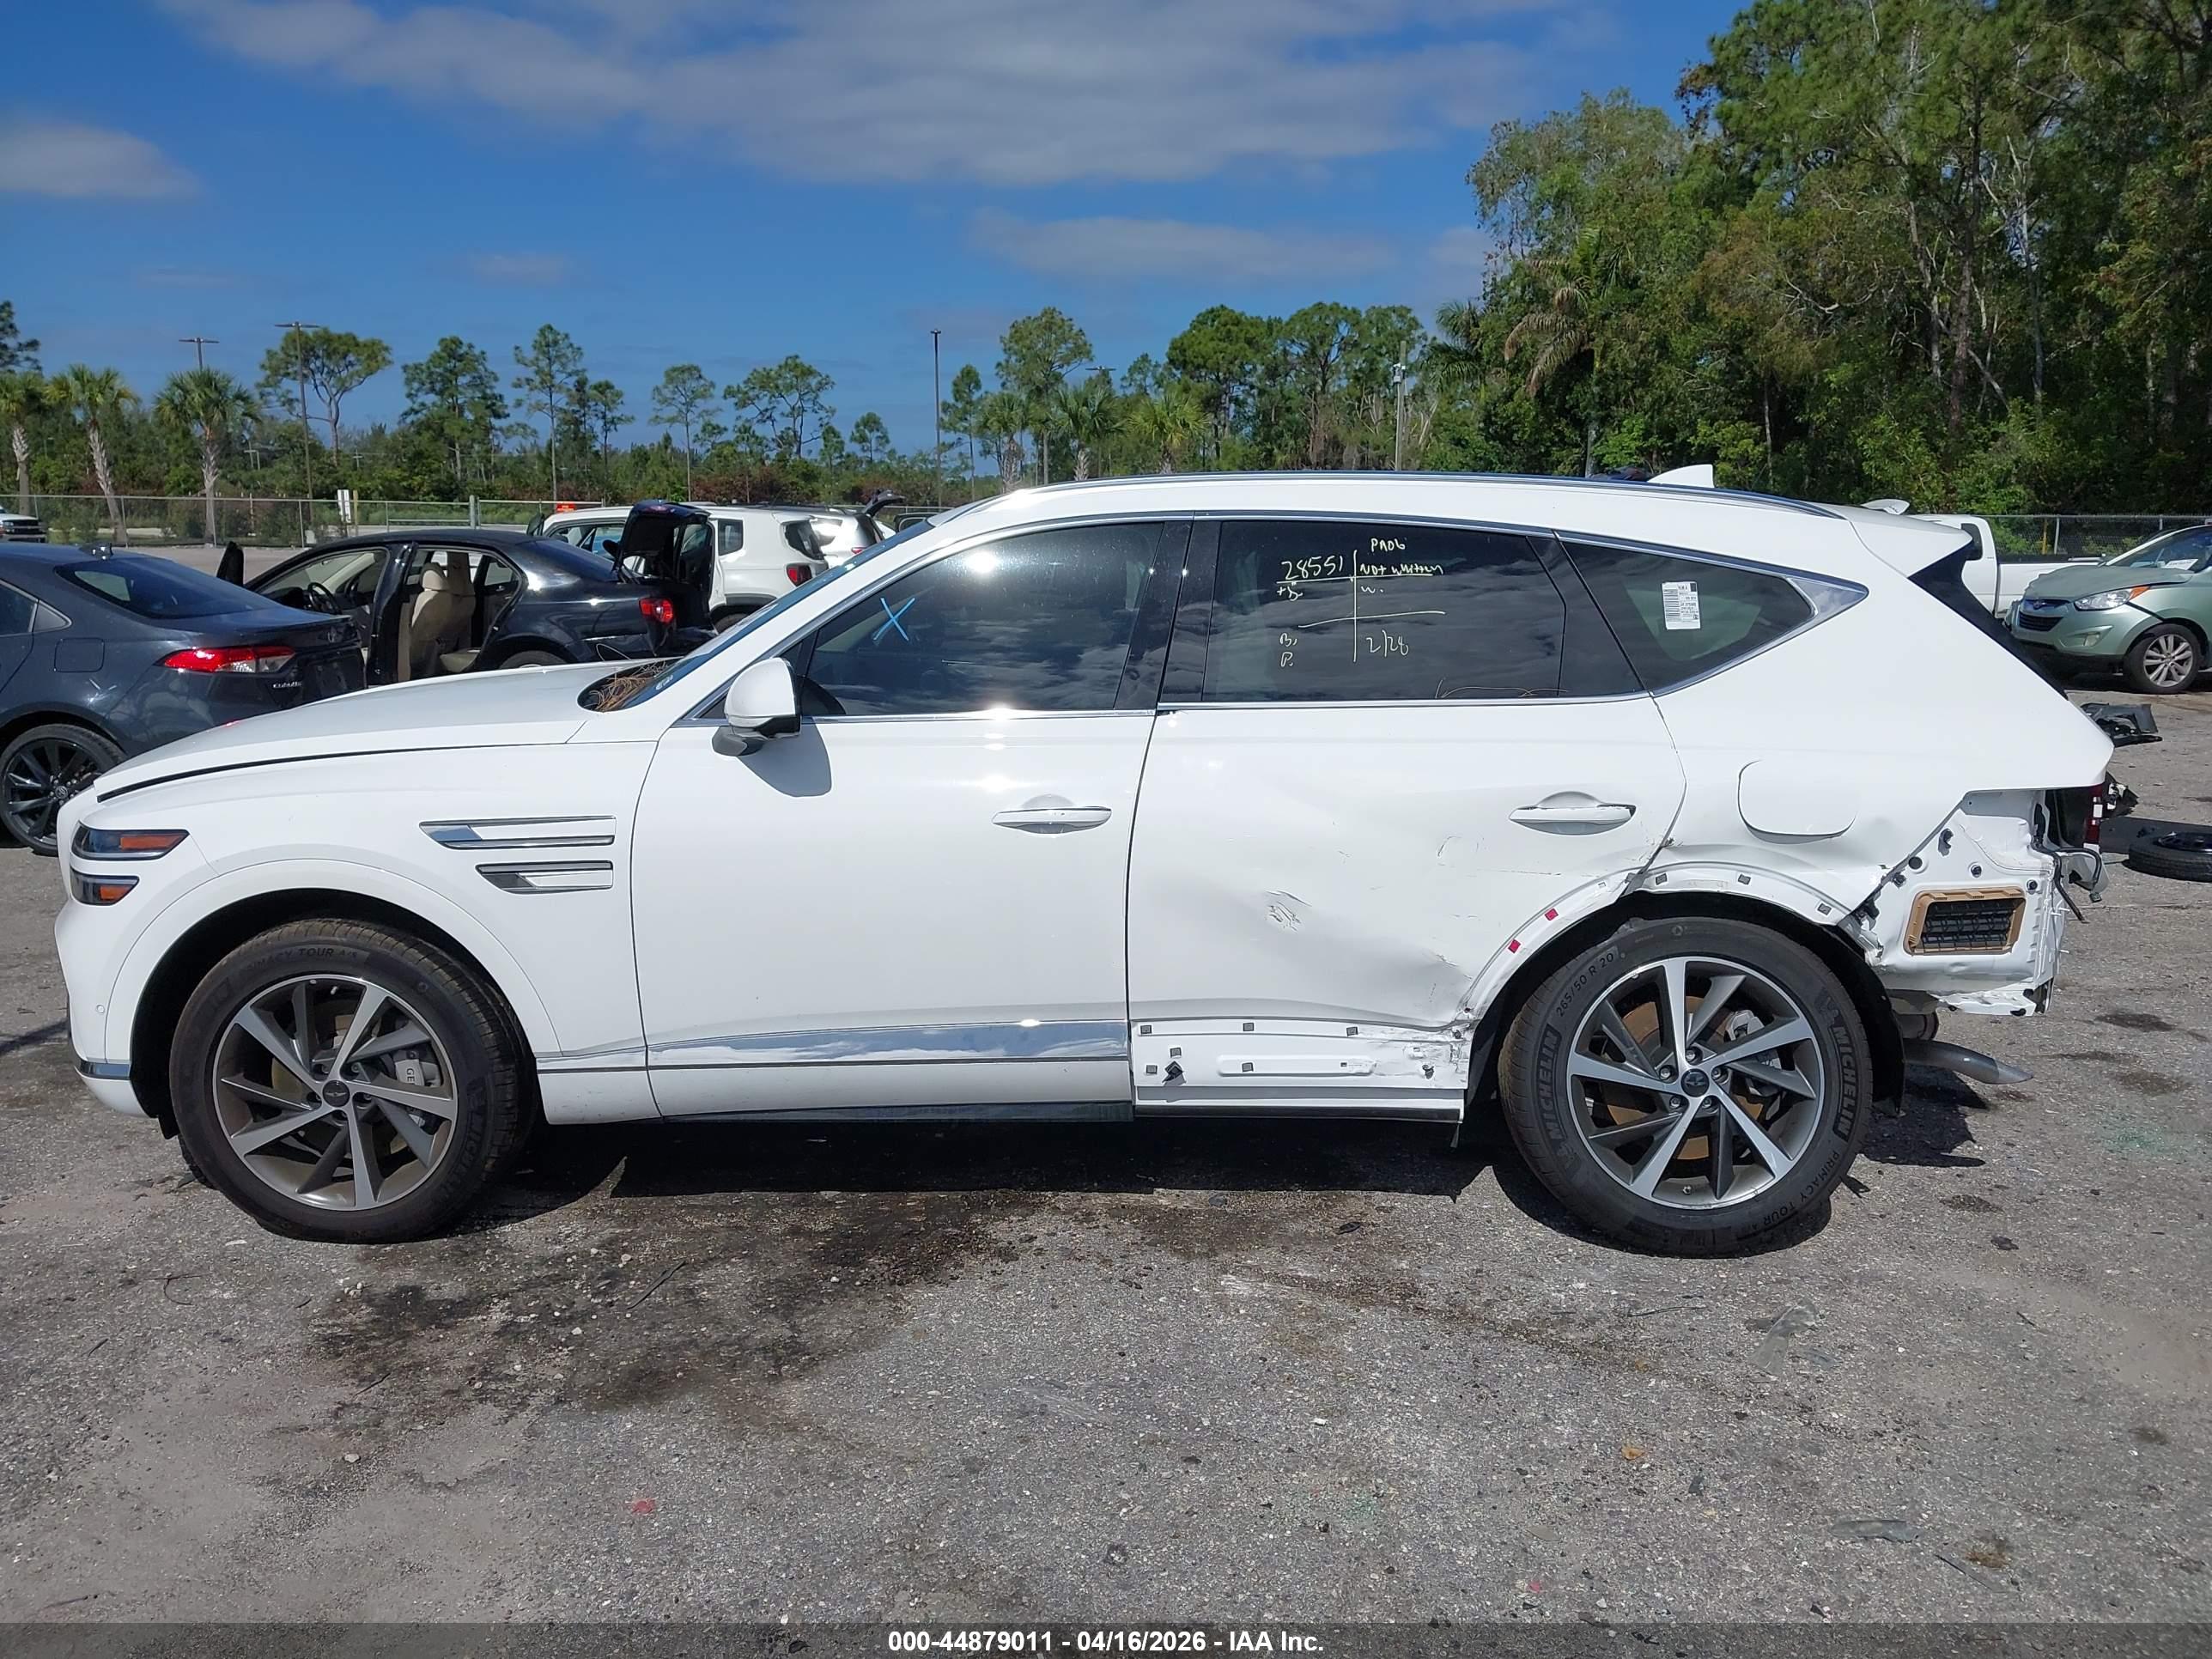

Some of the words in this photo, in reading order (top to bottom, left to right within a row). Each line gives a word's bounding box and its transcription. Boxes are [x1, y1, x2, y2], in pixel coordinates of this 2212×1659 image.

[298, 947, 334, 957] TOUR
[1556, 974, 1588, 1017] 265/50
[1588, 965, 1598, 976] R
[1599, 952, 1614, 968] 20
[1538, 1027, 1563, 1139] MICHELIN
[1833, 1026, 1857, 1137] MICHELIN
[1800, 1150, 1840, 1201] PRIMACY
[1764, 1202, 1796, 1225] TOUR
